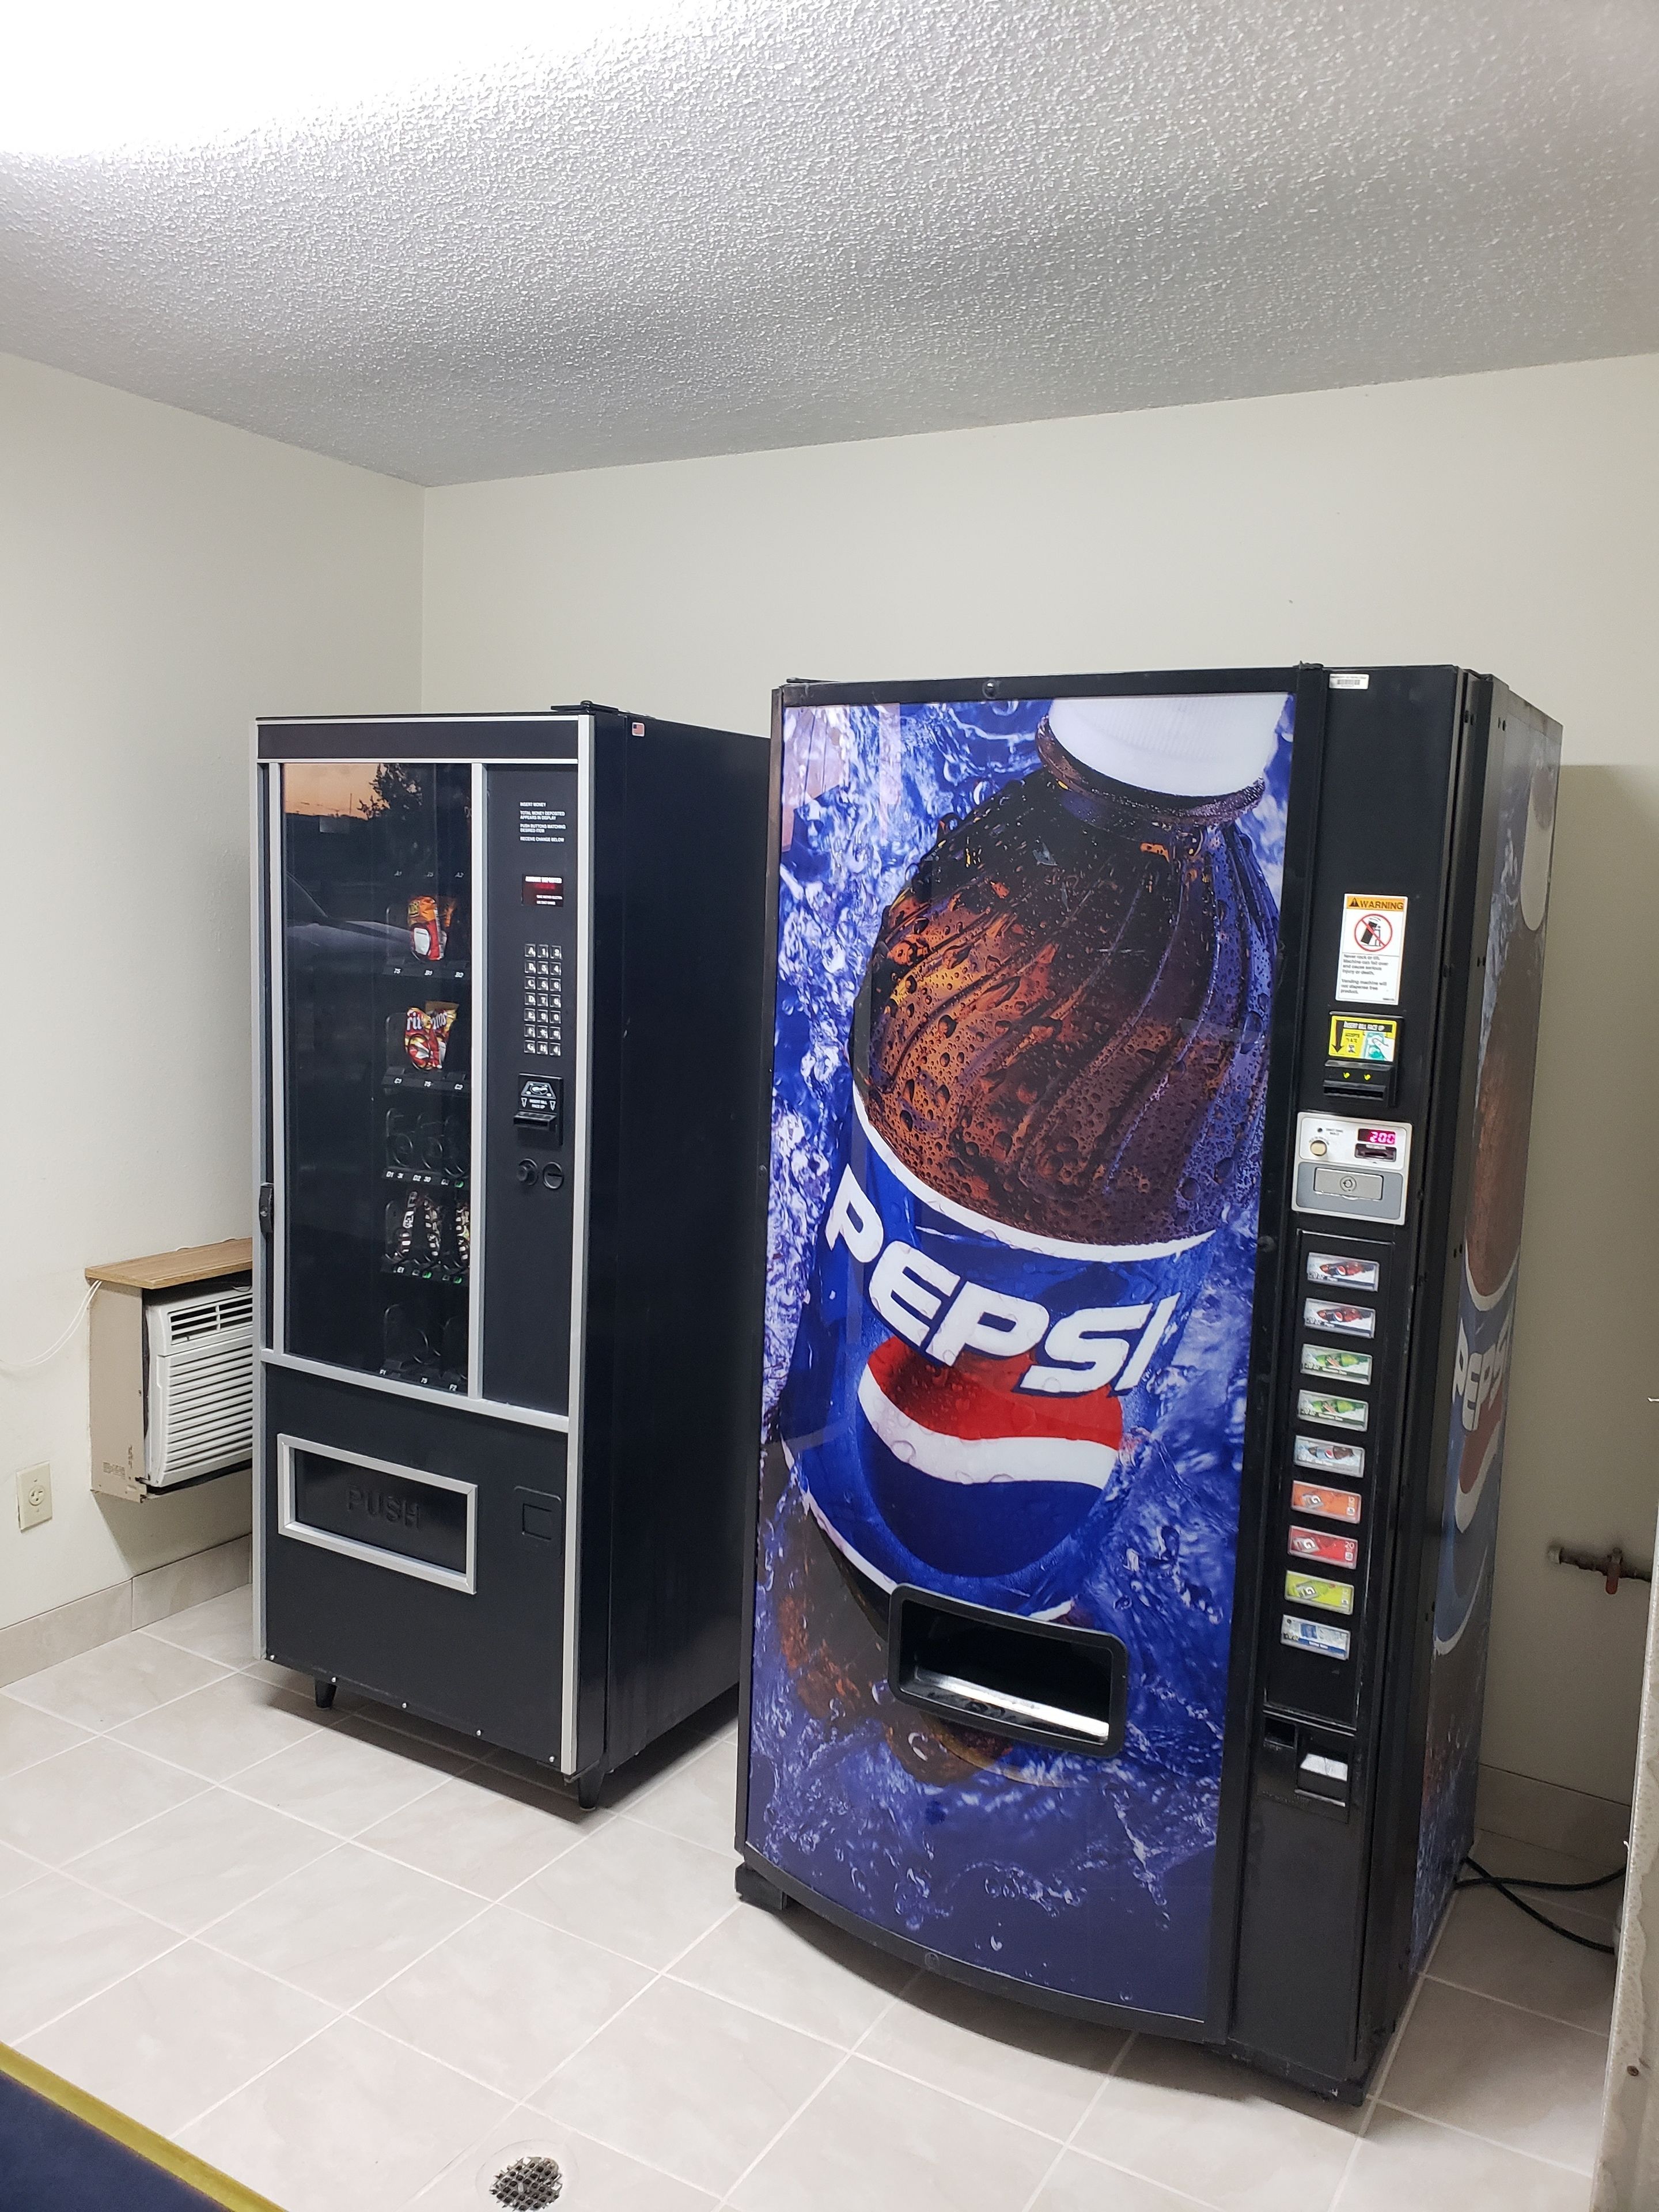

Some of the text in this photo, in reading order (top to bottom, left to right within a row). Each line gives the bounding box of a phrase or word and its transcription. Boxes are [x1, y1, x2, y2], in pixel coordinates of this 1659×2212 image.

[1360, 900, 1404, 910] WARNING
[825, 1164, 1181, 1393] PEPSI
[347, 1484, 419, 1528] PUSH
[1344, 1540, 1355, 1550] 20
